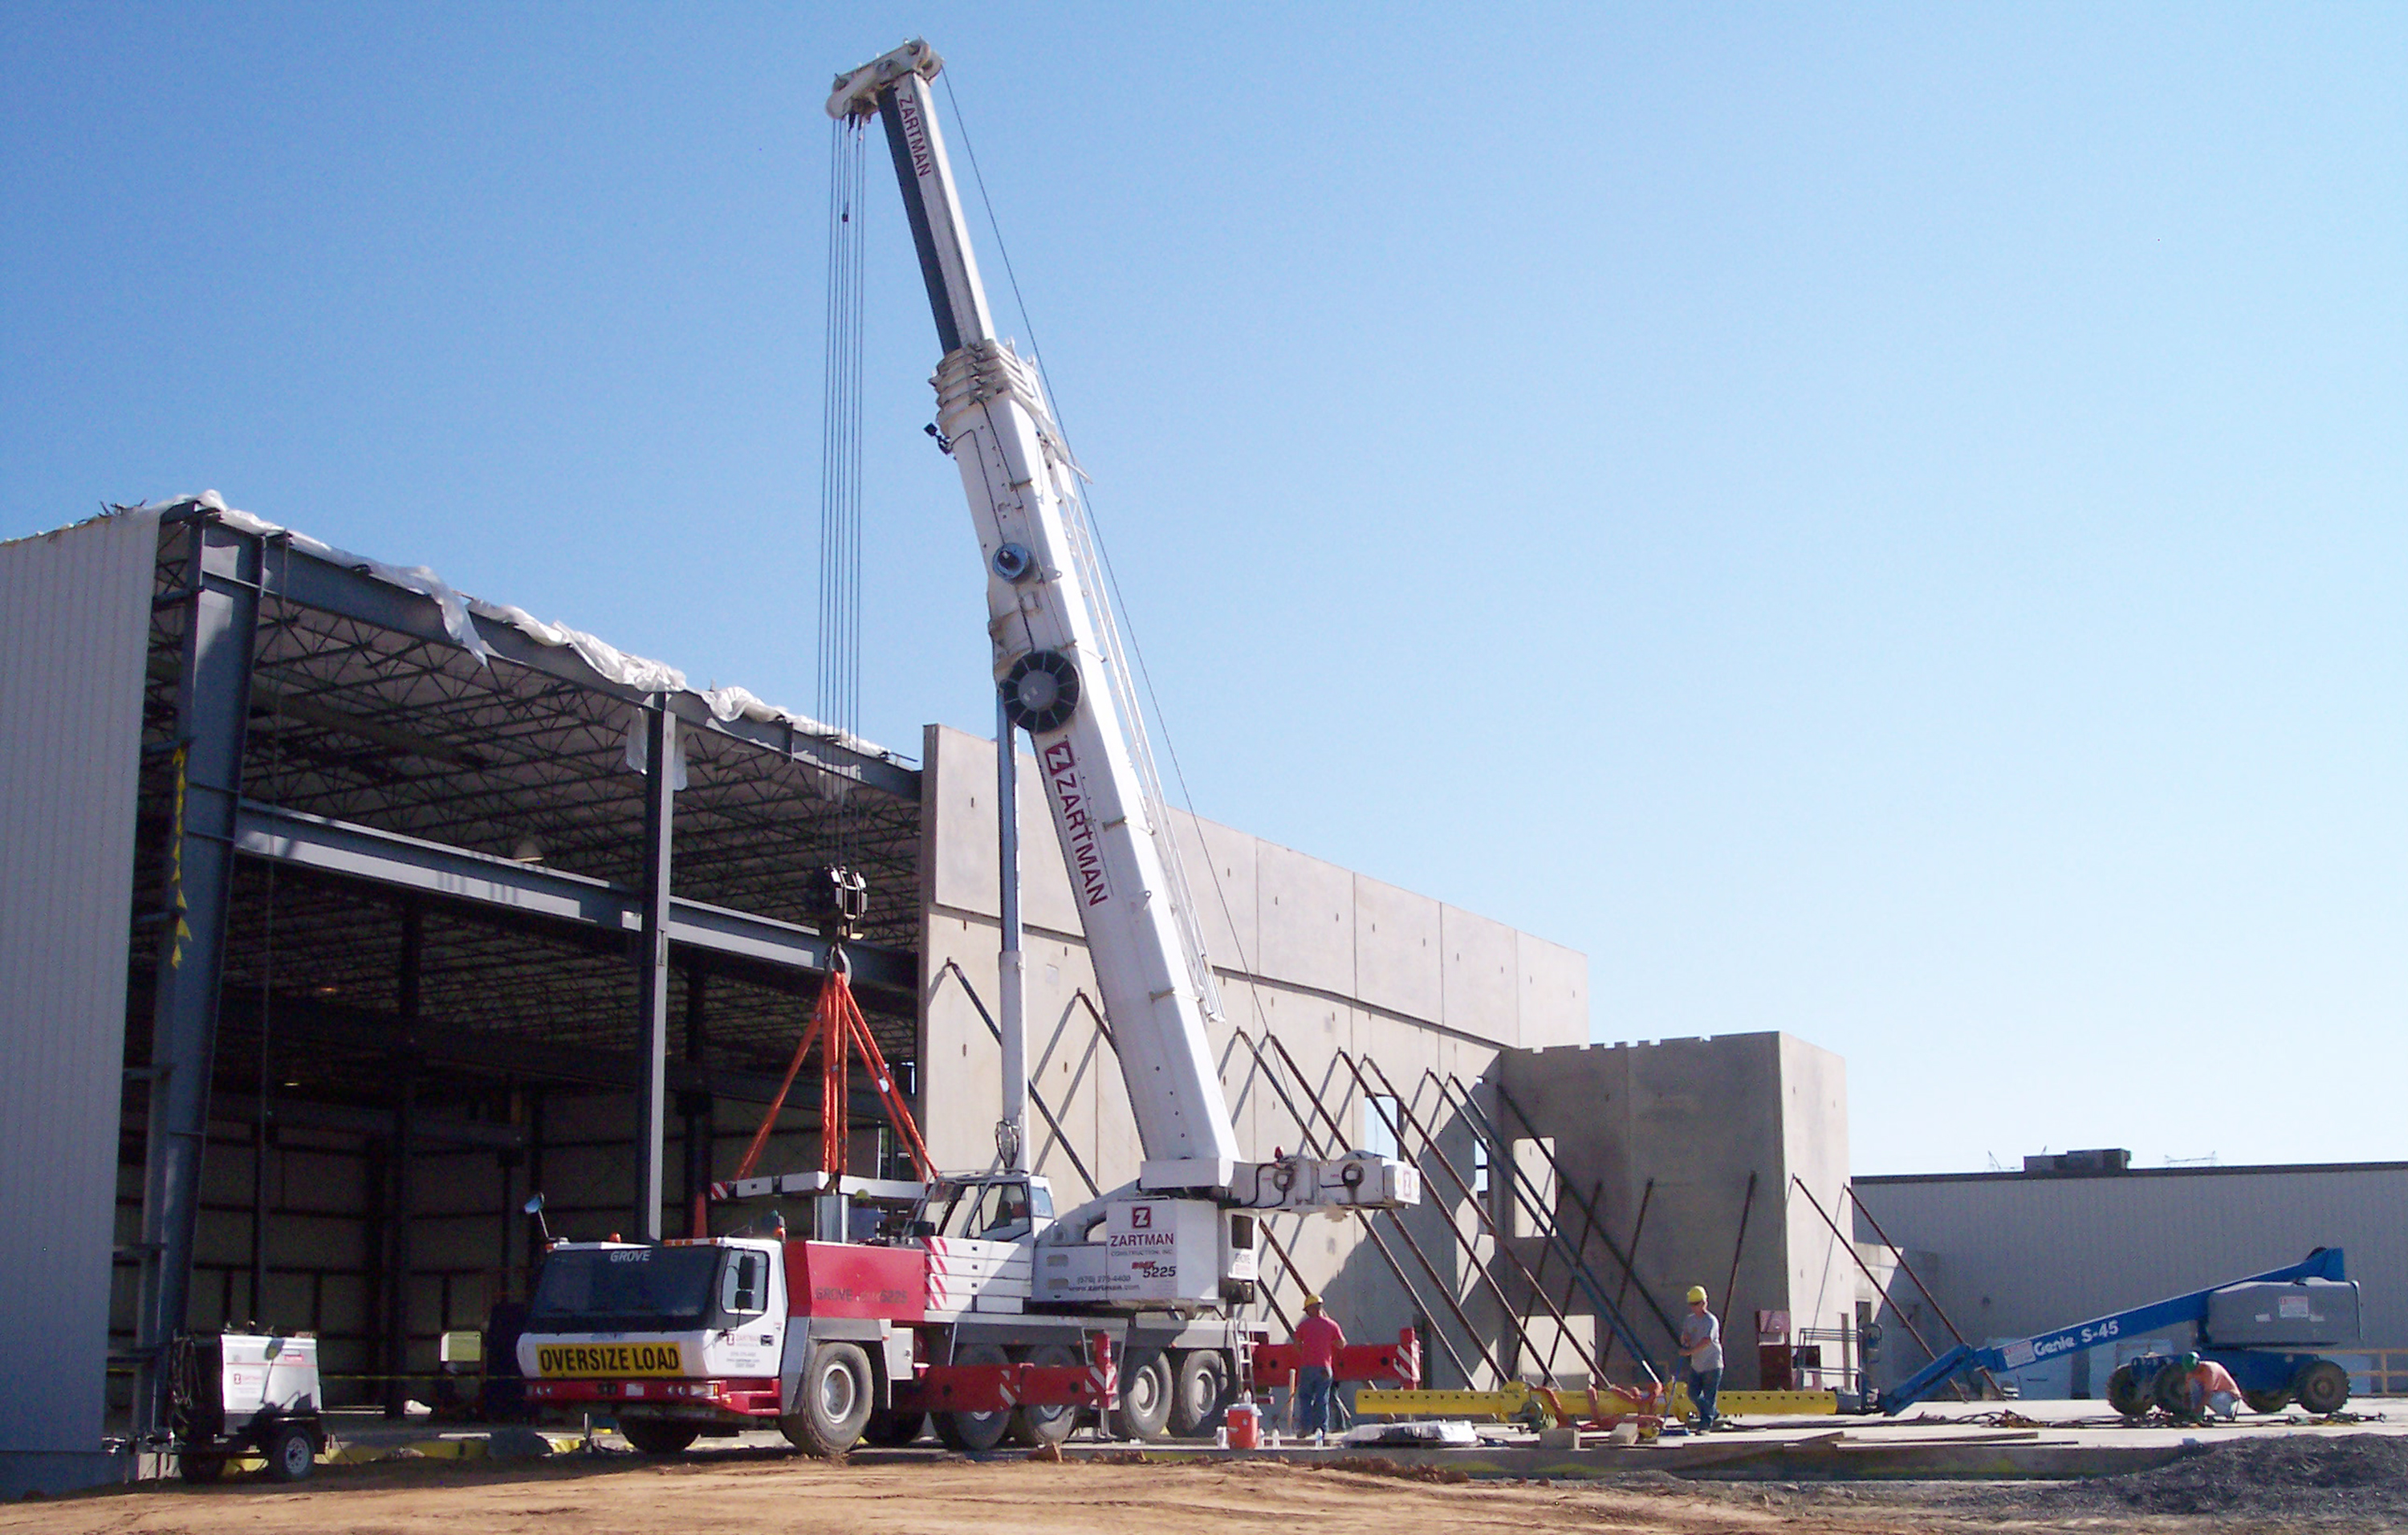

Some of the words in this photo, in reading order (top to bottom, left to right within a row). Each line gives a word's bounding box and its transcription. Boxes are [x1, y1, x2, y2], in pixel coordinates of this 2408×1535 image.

[899, 95, 932, 177] ZARTMAN
[1056, 772, 1108, 907] ZARTMAN
[1110, 1233, 1173, 1247] ZARTMAN
[610, 1250, 652, 1262] GROVE
[1143, 1266, 1176, 1277] 5225
[816, 1287, 852, 1301] GROVE
[2034, 1336, 2076, 1356] Genie
[2081, 1319, 2119, 1343] S-45
[540, 1347, 630, 1372] OVERSIZE
[633, 1346, 679, 1370] LOAD
